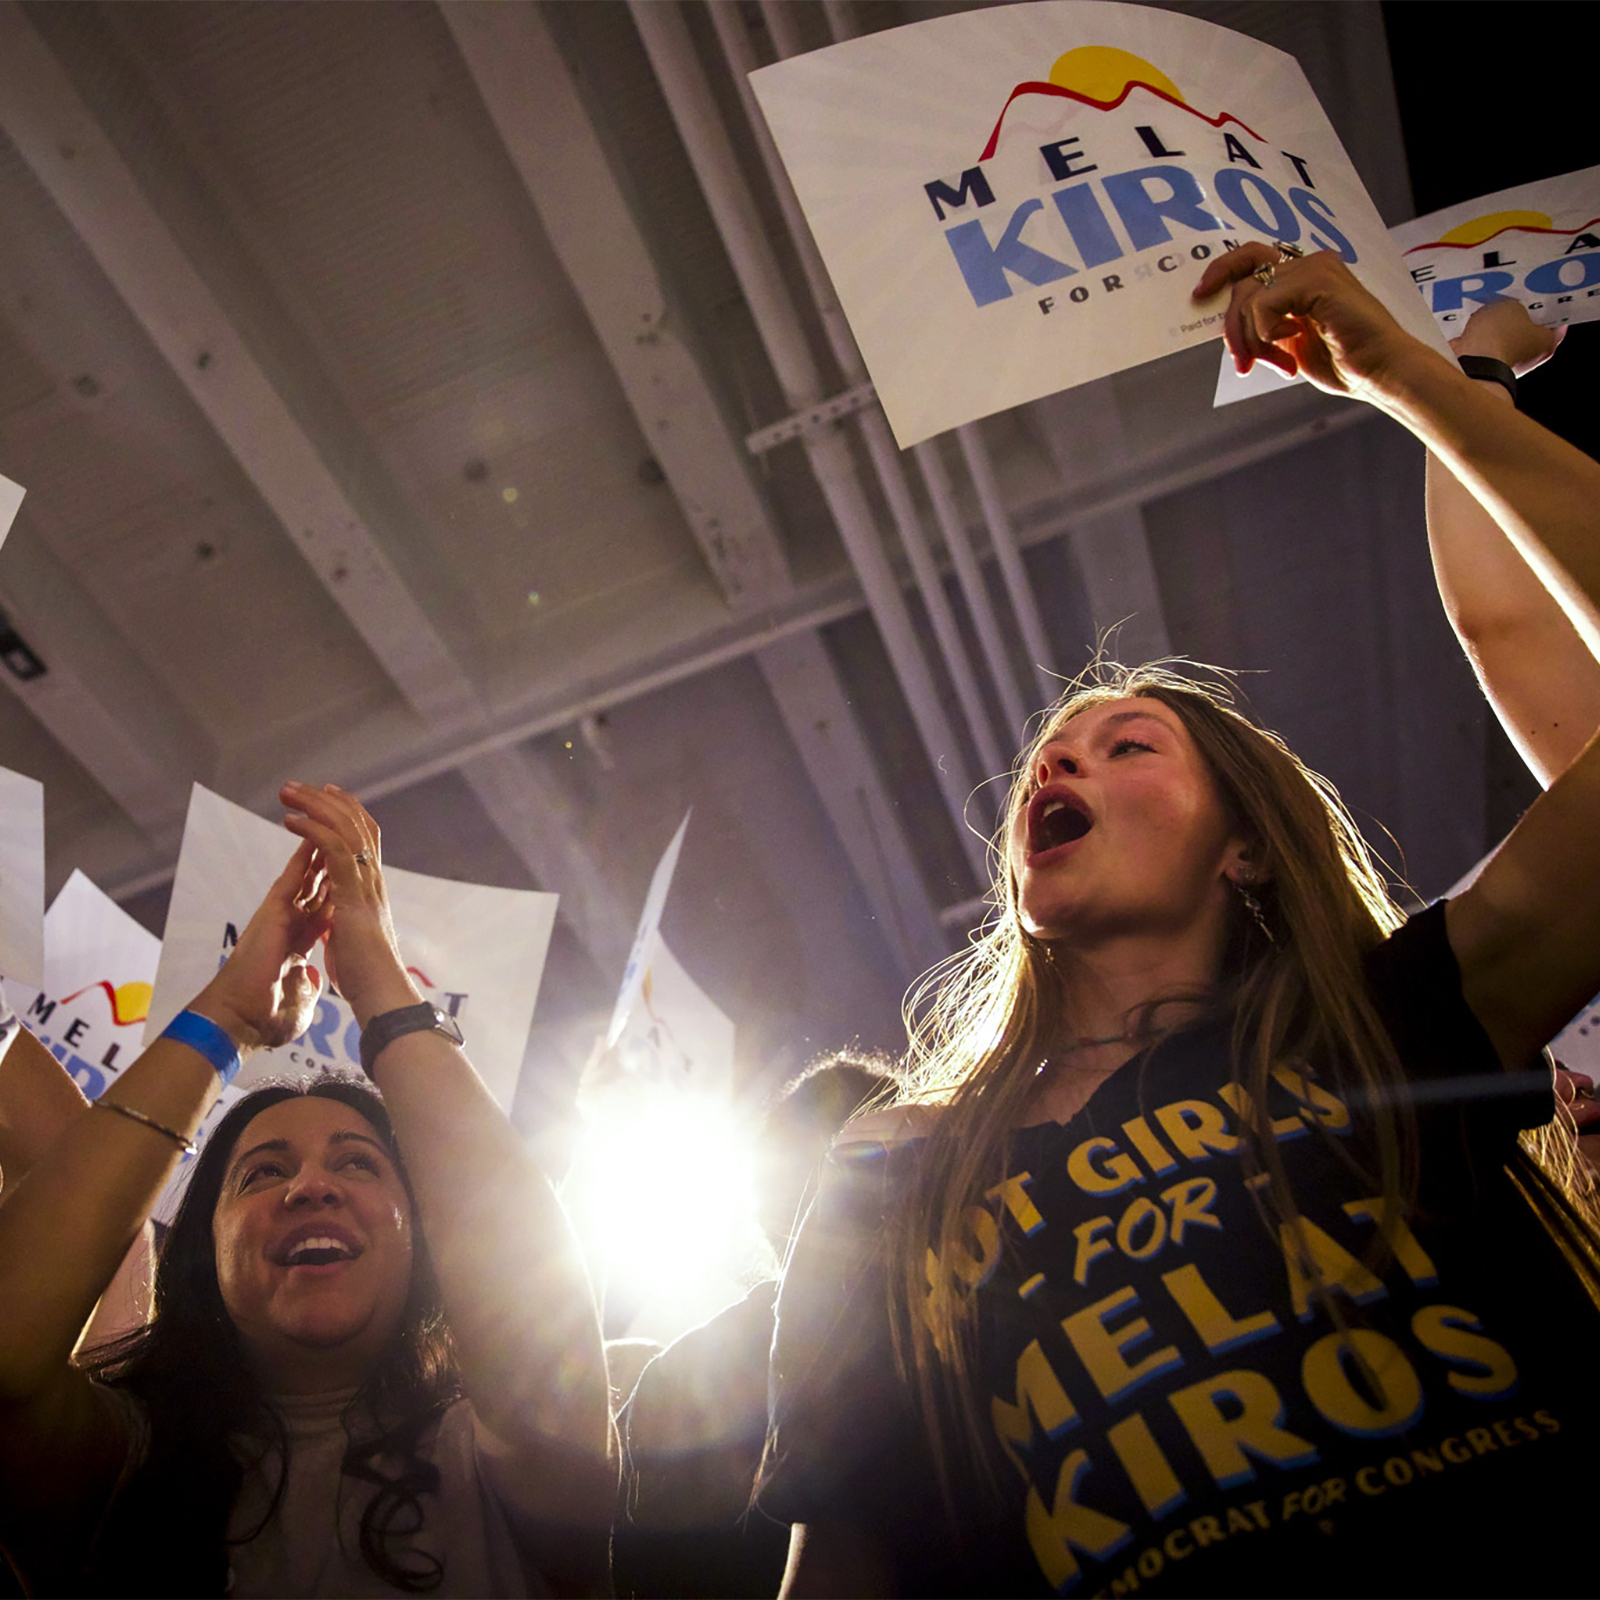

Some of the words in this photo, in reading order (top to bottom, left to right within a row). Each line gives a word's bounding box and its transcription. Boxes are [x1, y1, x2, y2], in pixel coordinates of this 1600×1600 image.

[924, 126, 1315, 221] MELAT
[944, 164, 1358, 308] KIROS
[1410, 233, 1600, 283] ELA
[1037, 275, 1123, 315] FOR
[1181, 320, 1202, 332] Paid
[27, 991, 119, 1073] MEL
[1067, 1062, 1353, 1197] GIRLS
[1073, 1177, 1223, 1286] FOR
[991, 1197, 1441, 1465] MELAT
[1024, 1304, 1523, 1596] KIROS
[1091, 1500, 1272, 1598] MOCRAT
[1281, 1475, 1349, 1522] FOR
[1354, 1408, 1563, 1497] CONGRESS
